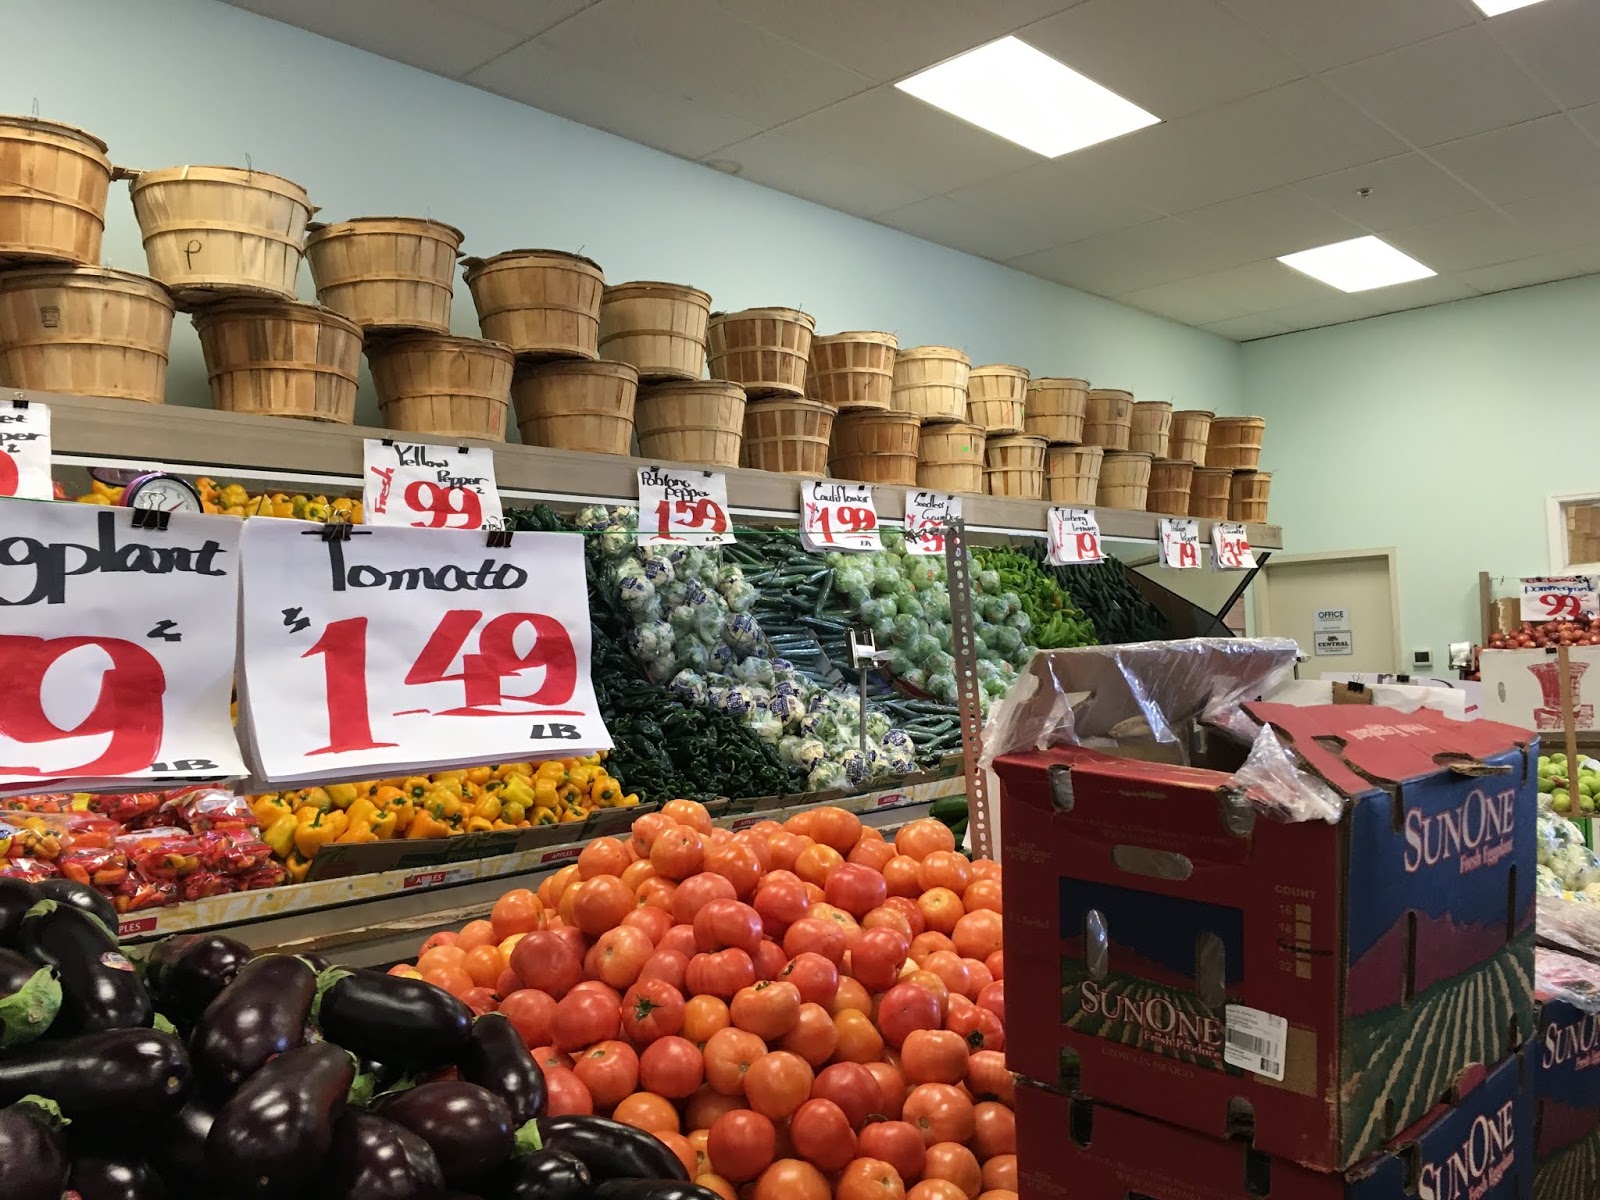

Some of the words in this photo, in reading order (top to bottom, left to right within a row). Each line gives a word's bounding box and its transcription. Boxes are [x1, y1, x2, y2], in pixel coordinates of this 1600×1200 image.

[0, 414, 28, 424] et
[0, 432, 48, 446] per
[394, 444, 449, 467] Yellow
[371, 466, 395, 514] Fresh
[437, 470, 490, 490] Pepper
[813, 484, 870, 502] Cauliflower
[404, 481, 483, 530] 99
[0, 511, 228, 606] gplant
[302, 530, 528, 592] Tomato
[1318, 611, 1344, 619] OFFICE
[1539, 593, 1581, 617] 99
[0, 634, 167, 779] 9
[529, 723, 581, 740] LB
[416, 874, 442, 884] APPLES
[1274, 884, 1317, 899] COUNT
[119, 922, 141, 934] PLES
[1143, 1029, 1176, 1047] Fresh
[1176, 1039, 1222, 1058] Produce
